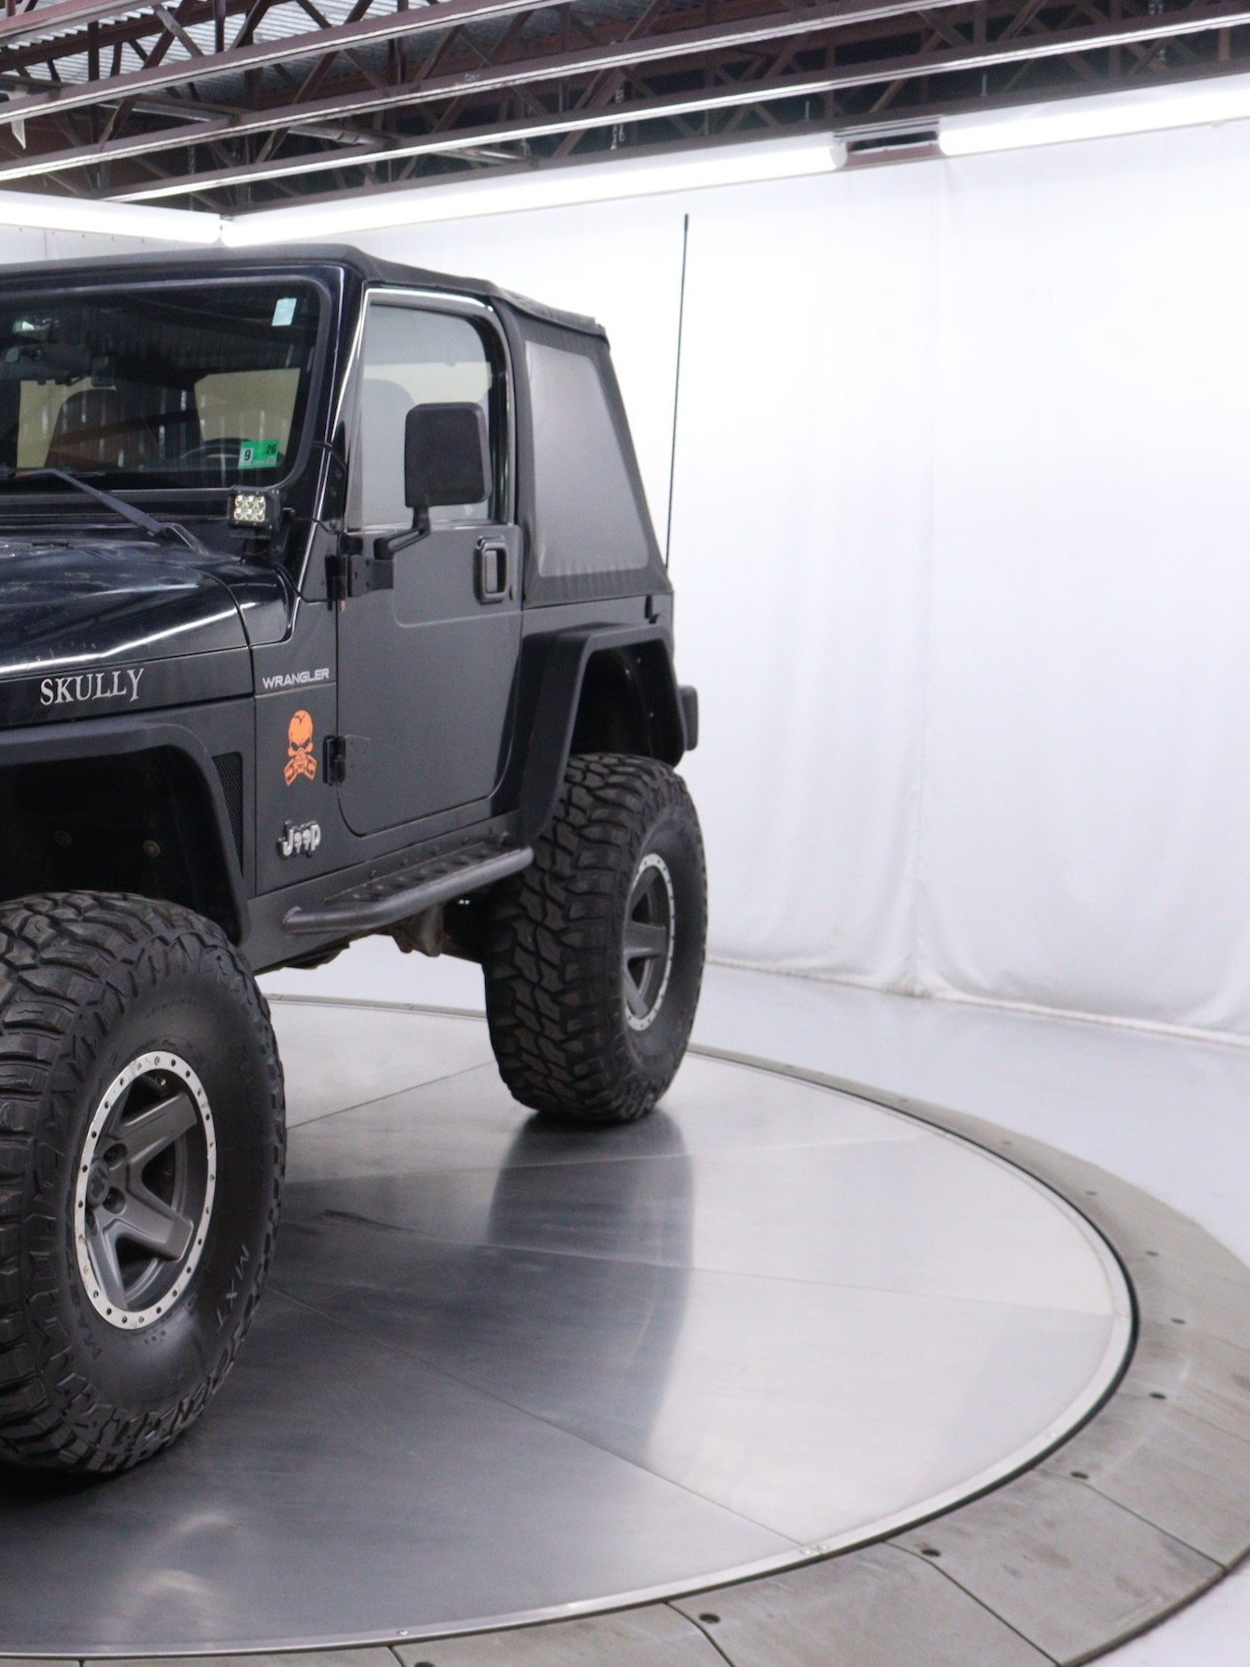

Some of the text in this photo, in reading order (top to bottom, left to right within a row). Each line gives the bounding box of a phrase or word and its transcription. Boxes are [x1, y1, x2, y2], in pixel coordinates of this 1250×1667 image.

[40, 667, 144, 705] SKULLY
[262, 667, 330, 689] WRANGLER
[279, 821, 321, 856] Jeep
